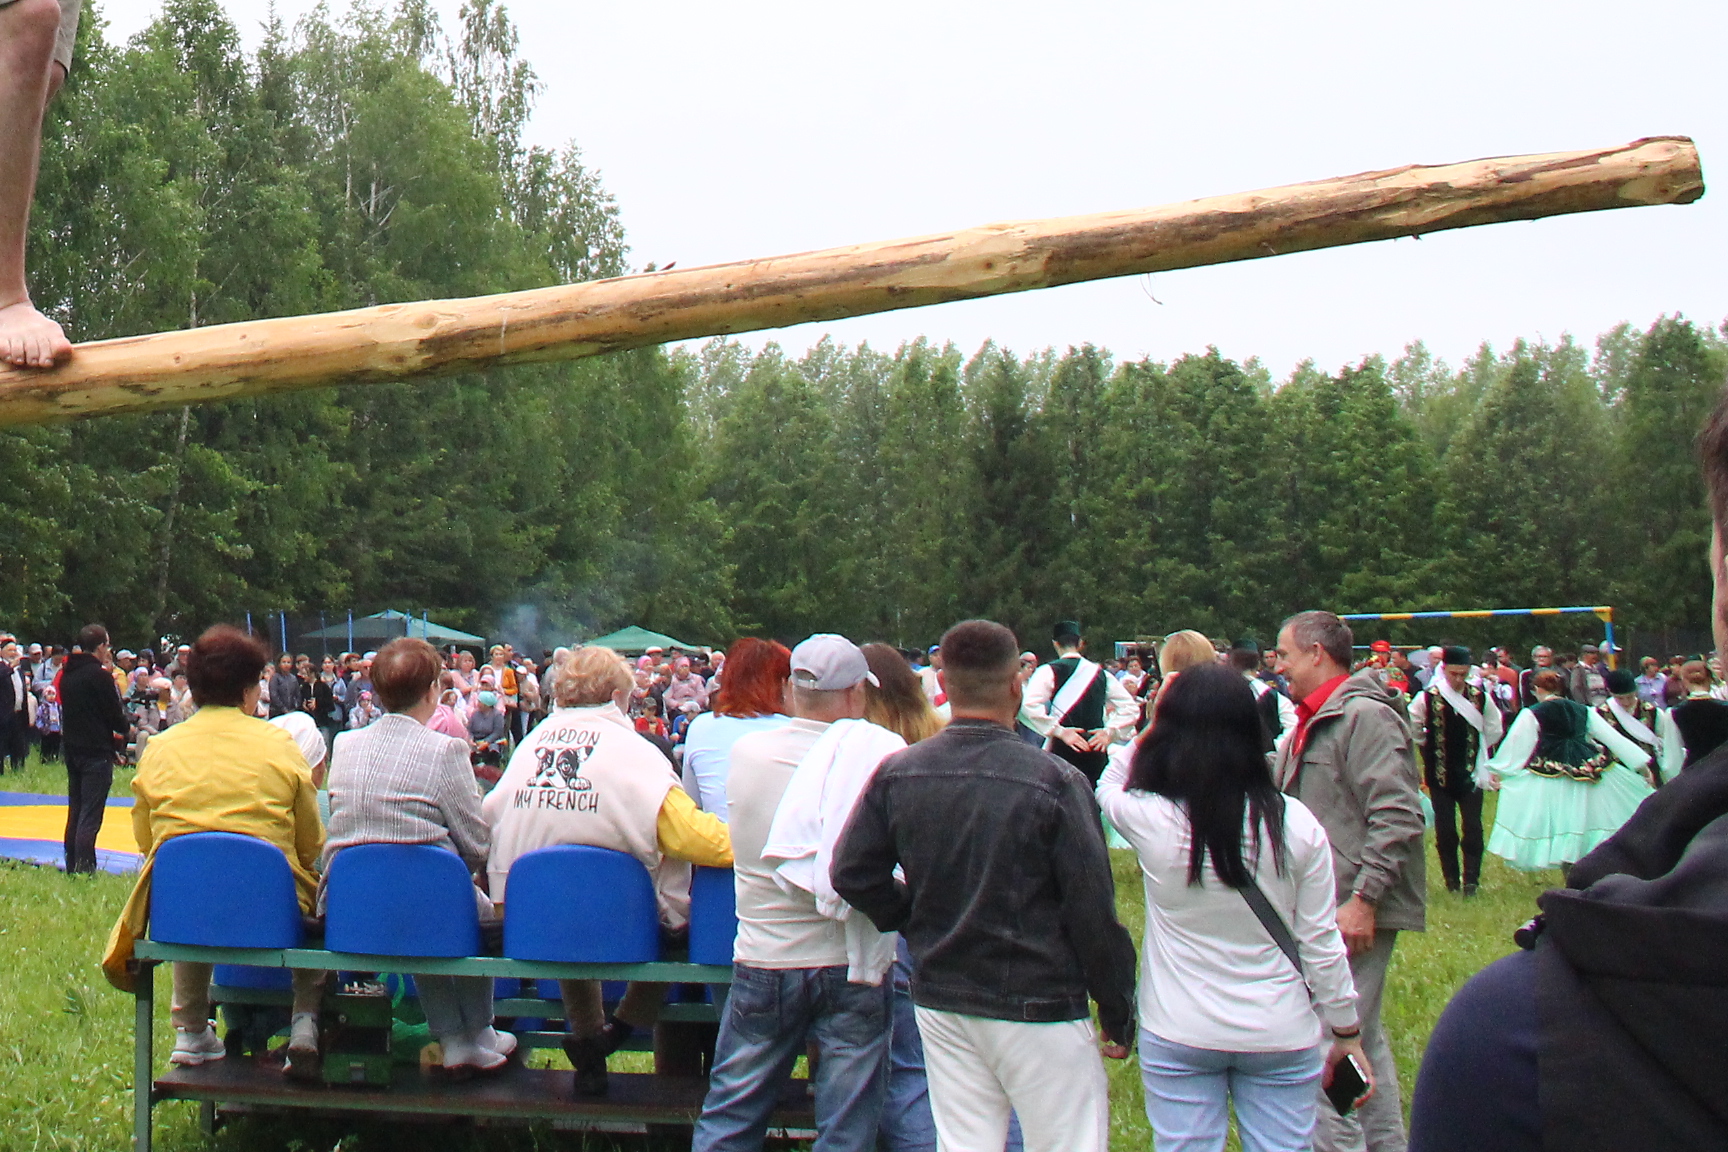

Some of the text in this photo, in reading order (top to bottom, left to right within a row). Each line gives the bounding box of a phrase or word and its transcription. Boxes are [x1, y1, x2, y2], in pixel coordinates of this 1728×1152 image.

[537, 728, 601, 746] PARDON
[514, 789, 599, 813] MY FRENCH
